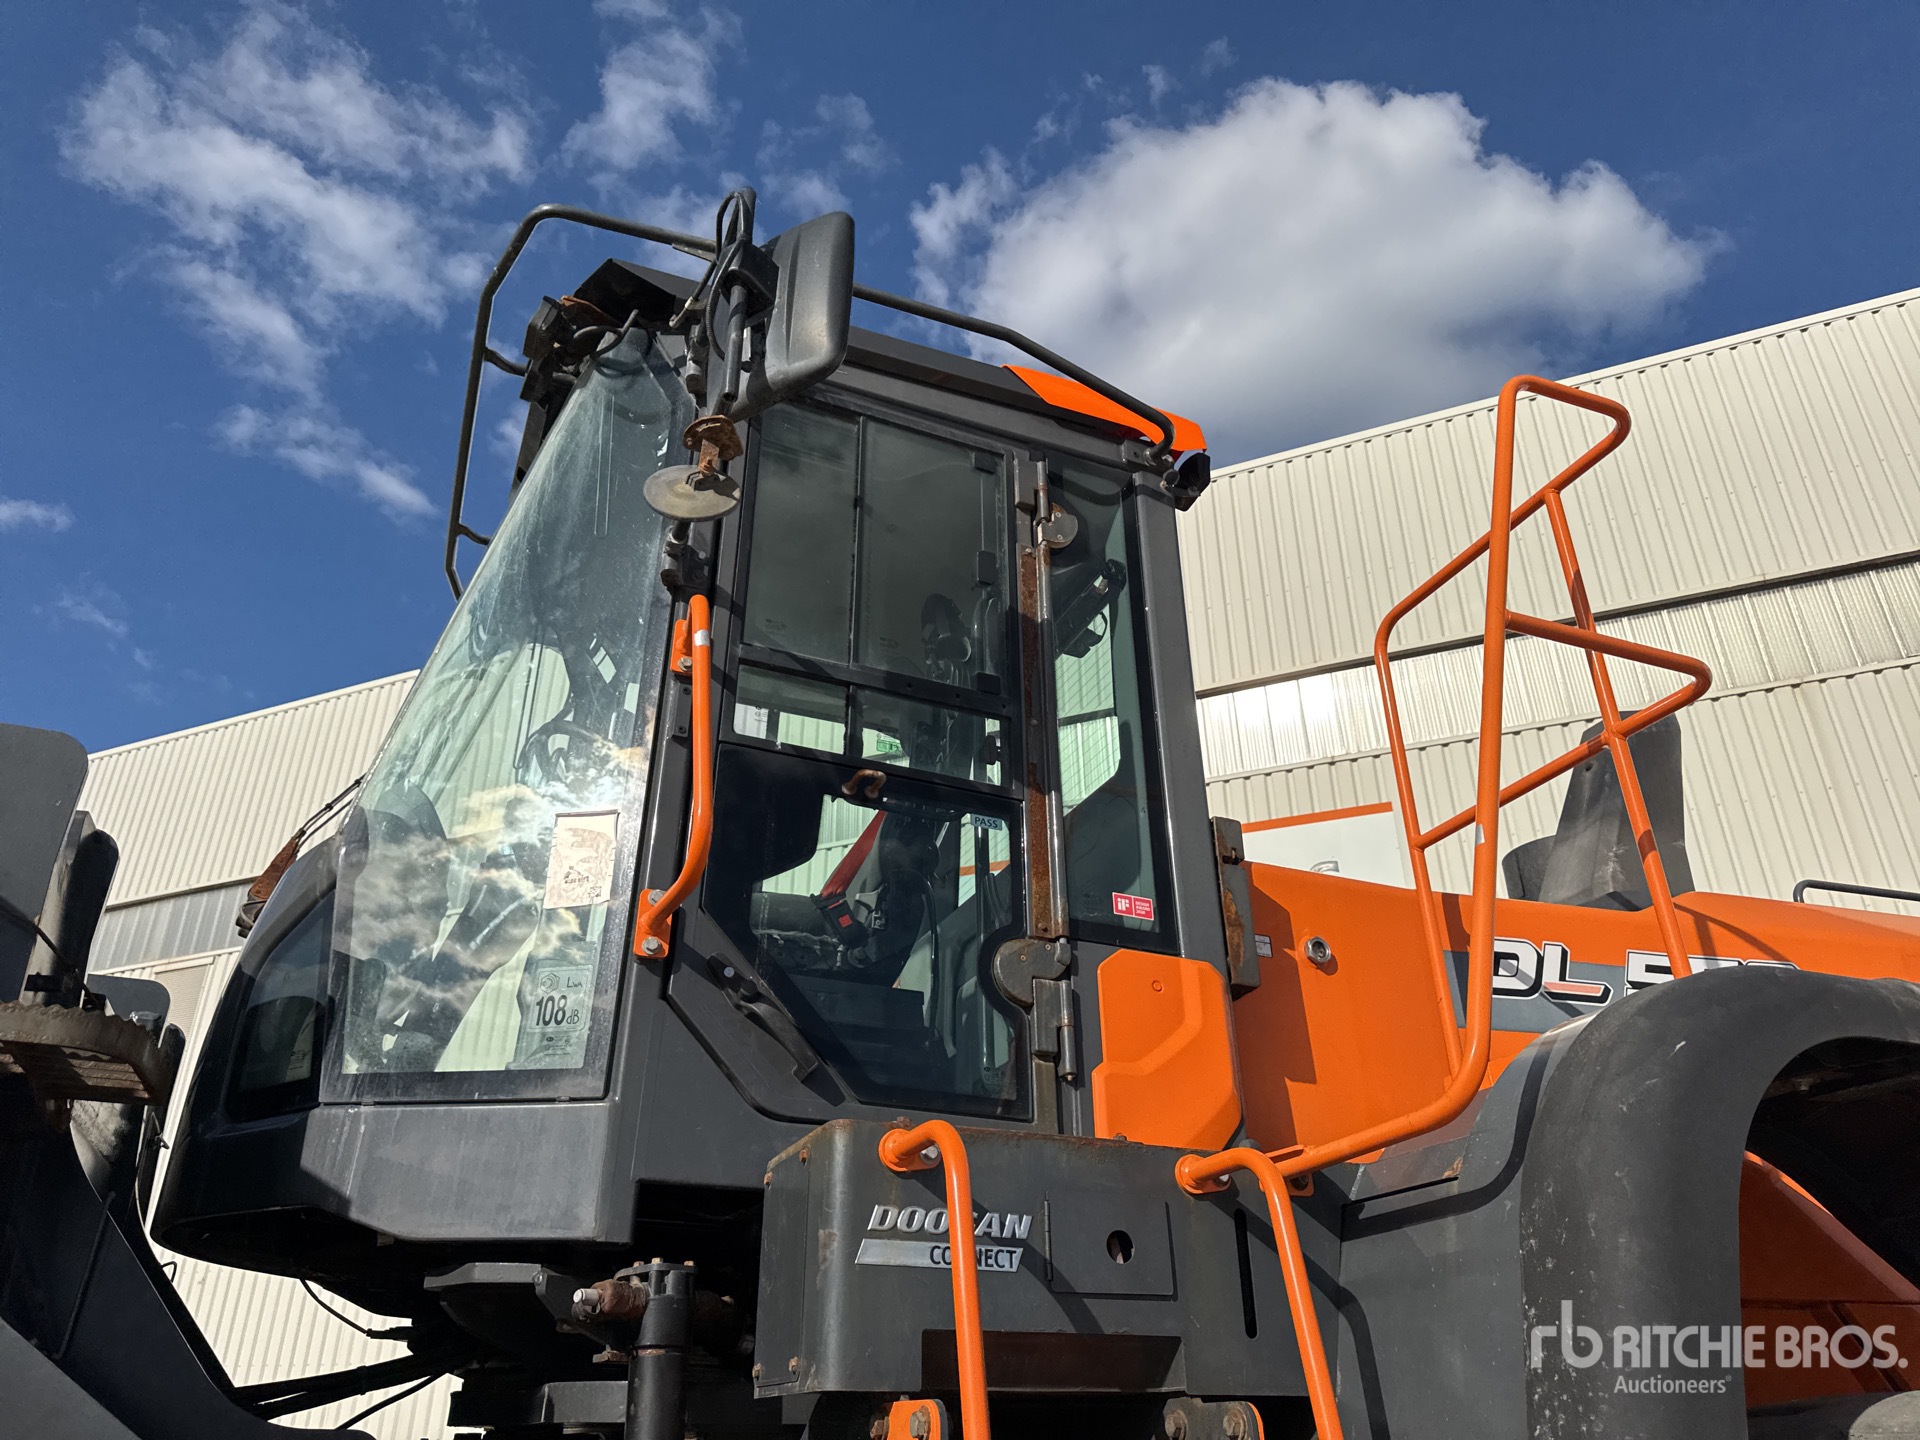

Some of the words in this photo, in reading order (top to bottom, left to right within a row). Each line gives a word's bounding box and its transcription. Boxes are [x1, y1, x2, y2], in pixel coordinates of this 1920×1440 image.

[974, 816, 998, 828] PASS
[1117, 897, 1130, 911] iF
[1493, 936, 1613, 1006] DL
[536, 994, 568, 1027] 108
[566, 1009, 580, 1025] dB
[867, 1204, 1033, 1240] DOOAN
[929, 1245, 1017, 1269] CONECT
